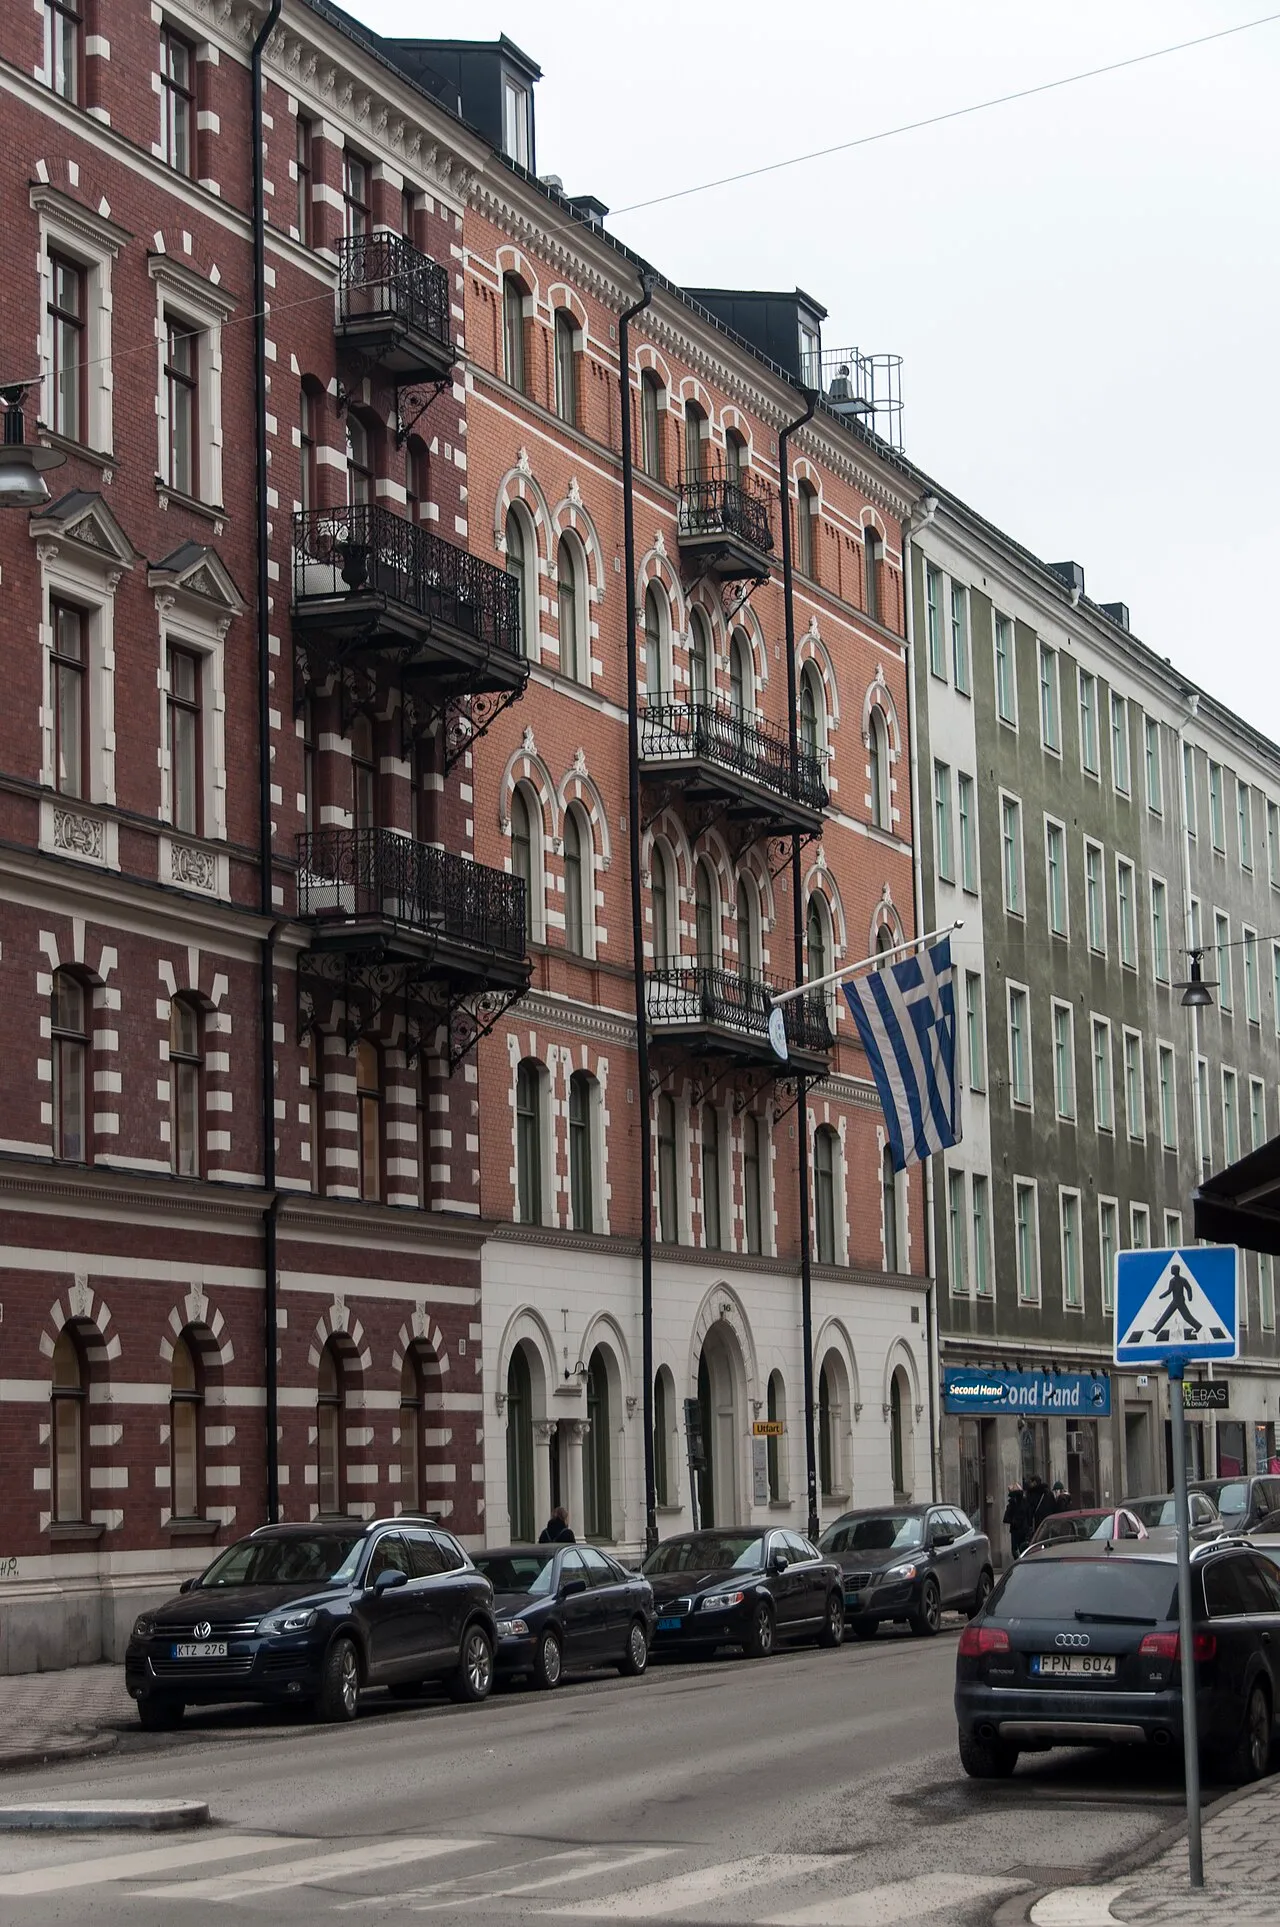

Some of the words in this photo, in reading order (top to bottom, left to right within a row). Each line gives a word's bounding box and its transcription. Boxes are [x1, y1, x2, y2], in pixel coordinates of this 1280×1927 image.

[949, 1384, 980, 1395] Second
[979, 1385, 1003, 1396] Hand
[1041, 1381, 1080, 1407] Hand
[1191, 1400, 1210, 1408] beauty
[756, 1424, 780, 1433] Utfart
[178, 1645, 197, 1656] KTZ
[204, 1644, 225, 1655] 276
[1041, 1656, 1071, 1671] FPN
[1082, 1657, 1112, 1672] 604
